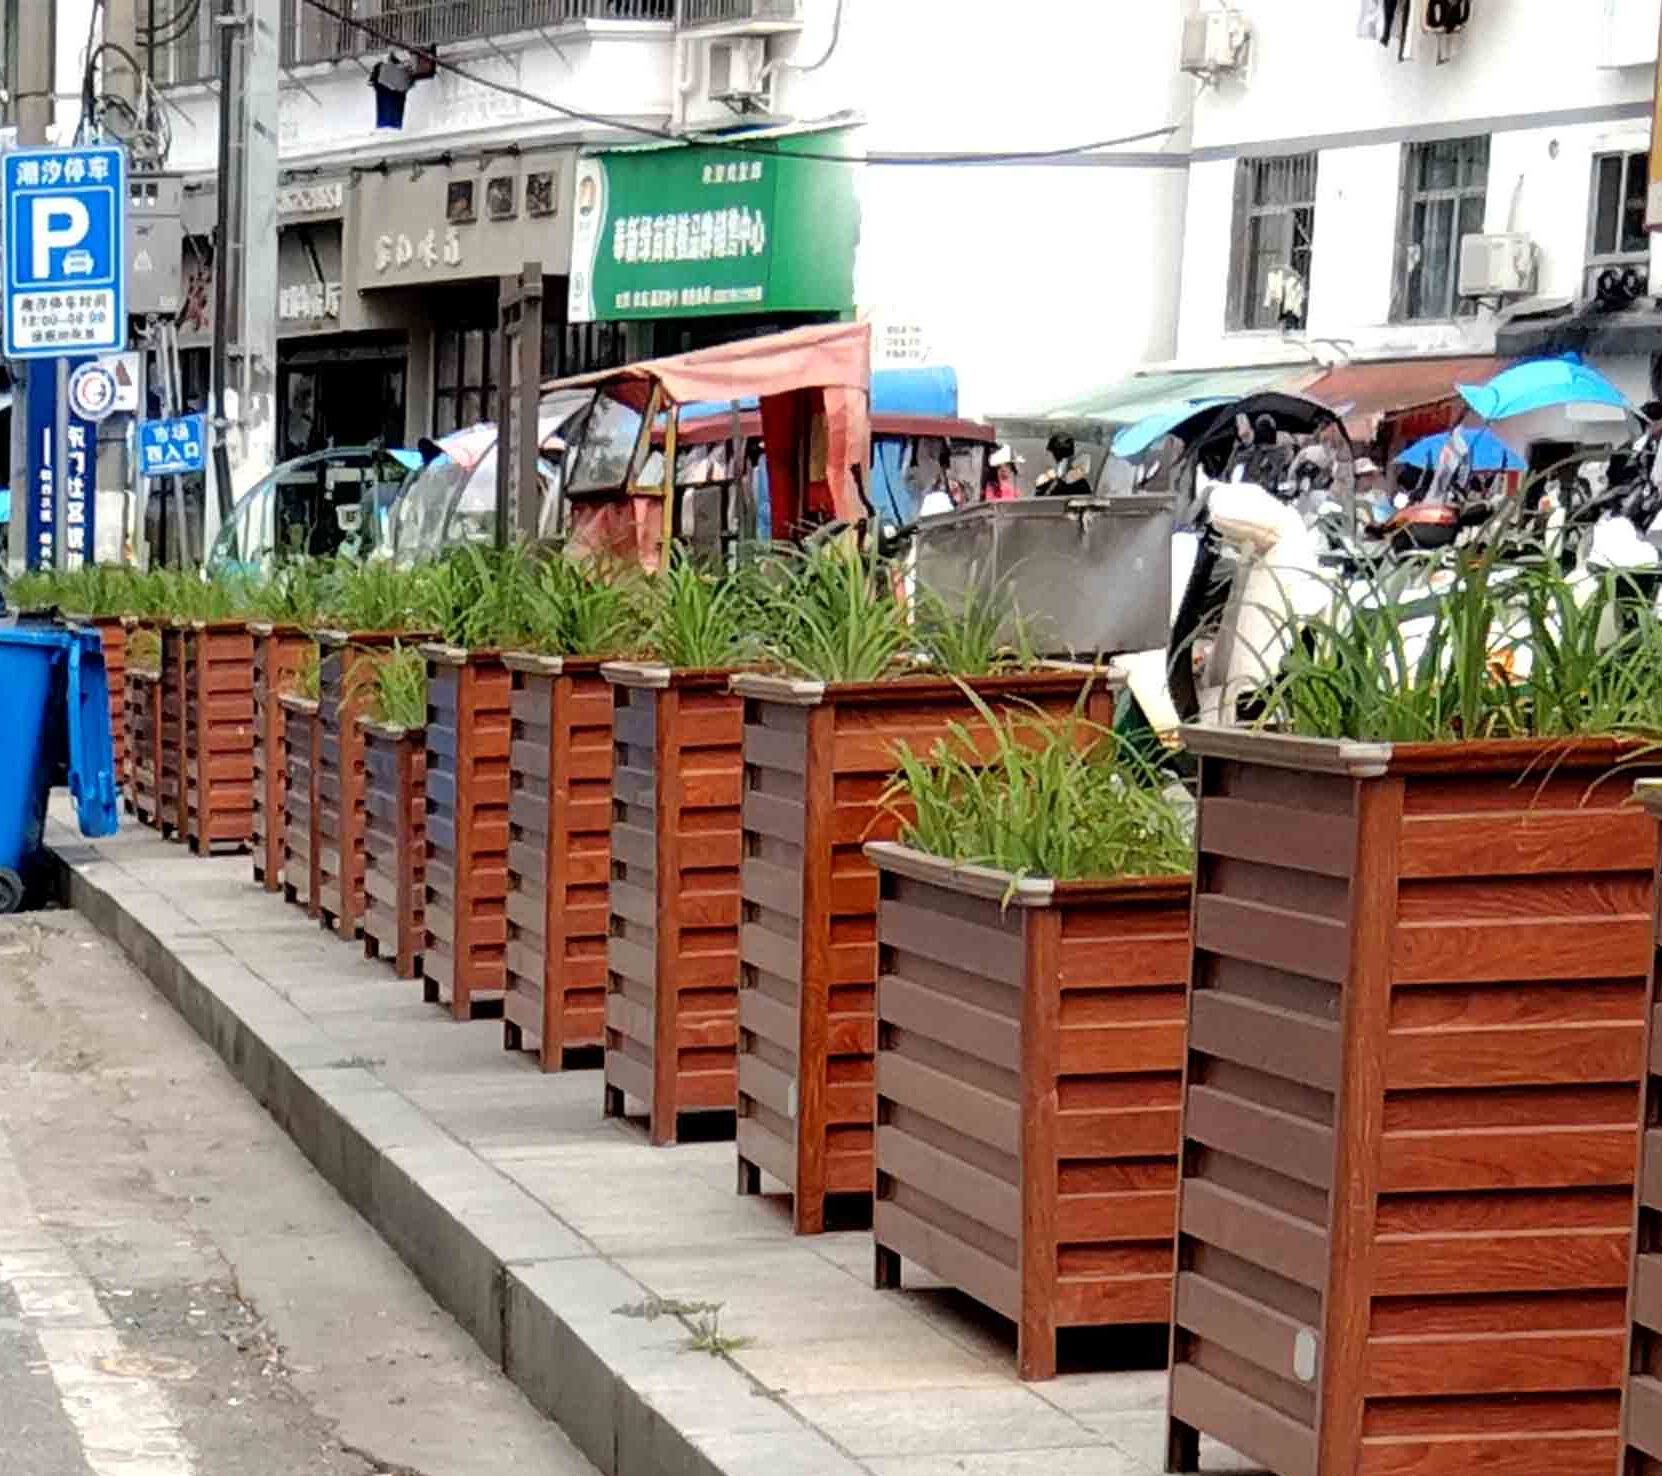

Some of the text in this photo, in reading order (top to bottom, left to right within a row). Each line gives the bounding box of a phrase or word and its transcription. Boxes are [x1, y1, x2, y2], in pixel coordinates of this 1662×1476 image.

[16, 156, 109, 186] 潮汐停车
[32, 196, 89, 280] P
